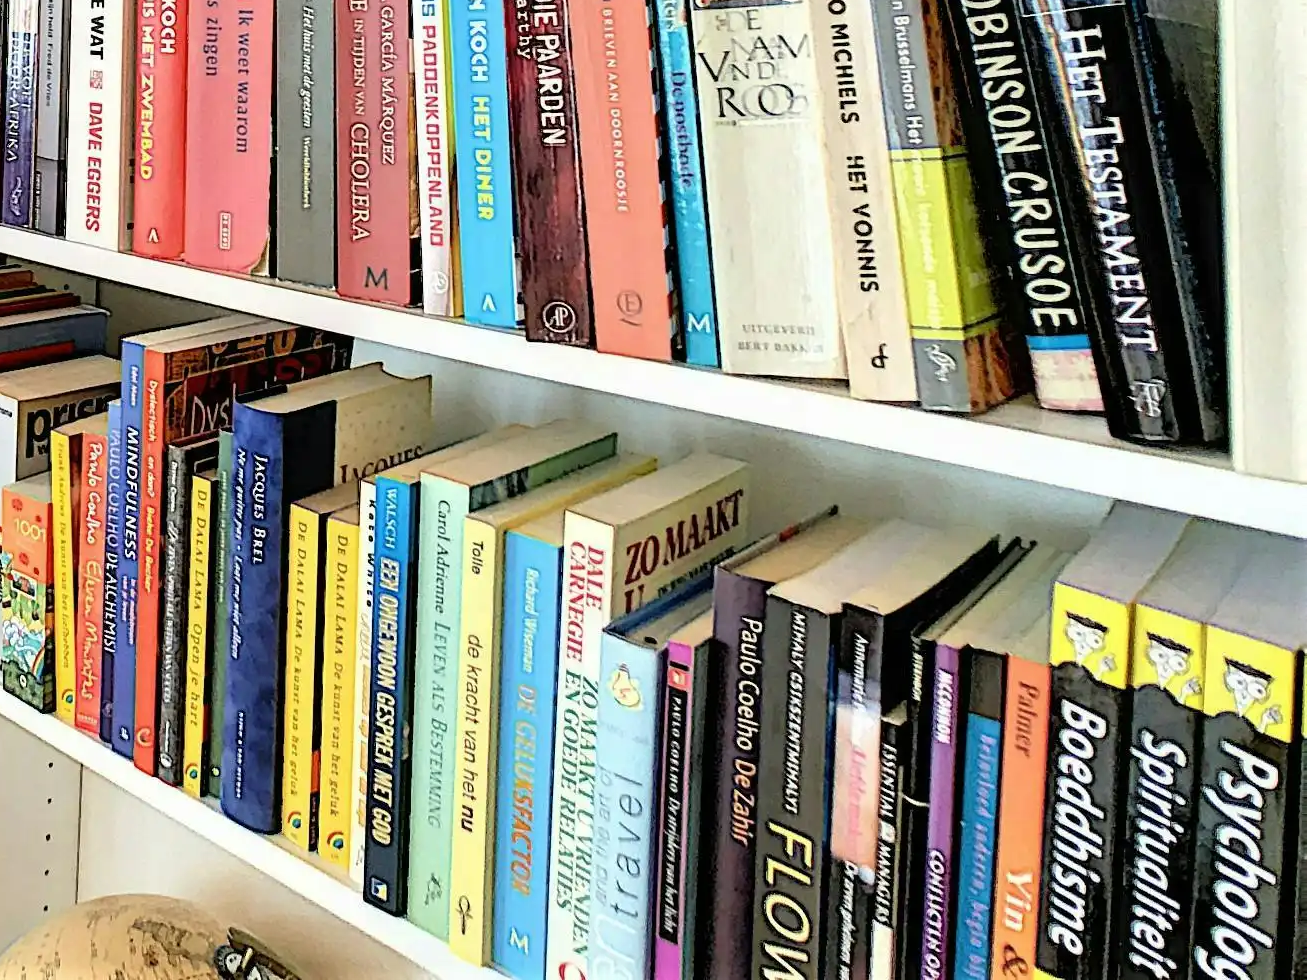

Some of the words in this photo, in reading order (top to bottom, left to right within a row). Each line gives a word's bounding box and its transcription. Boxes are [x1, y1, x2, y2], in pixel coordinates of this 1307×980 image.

[89, 15, 105, 60] WAT
[140, 24, 156, 67] MET
[205, 16, 221, 77] zingen
[237, 9, 253, 27] Ik
[352, 19, 364, 35] IN
[380, 6, 394, 72] GARCÍA
[237, 31, 251, 76] weet
[352, 36, 365, 88] TIJDEN
[468, 20, 489, 82] KOCH
[830, 23, 860, 124] MICHIELS
[891, 15, 917, 111] Brusselmans
[1061, 24, 1106, 104] HET
[235, 82, 250, 154] waarom
[353, 89, 365, 116] VAN
[380, 76, 397, 164] MÁRQUEZ
[472, 96, 492, 141] HET
[534, 33, 565, 146] PAARDEN
[87, 102, 104, 150] DAVE
[139, 73, 155, 180] ZWEMBAD
[421, 26, 444, 247] PADDENKOPPENLAND
[900, 115, 924, 146] Het
[84, 155, 103, 232] EGGERS
[349, 122, 371, 242] CHOLERA
[474, 149, 494, 221] DINER
[845, 155, 868, 194] HET
[851, 202, 880, 293] VONNIS
[1002, 170, 1079, 328] CRUSOE
[1082, 115, 1158, 353] TESTAMENT
[364, 266, 389, 290] M
[686, 311, 712, 335] M
[124, 426, 139, 561] MINDFULNESS
[252, 454, 270, 519] JACQUES
[253, 527, 267, 565] BREL
[380, 556, 401, 593] EEN
[471, 541, 484, 574] Tolle
[567, 541, 587, 663] CARNEGIE
[587, 545, 604, 610] DALE
[376, 595, 400, 691] ONGEWOON
[468, 634, 481, 659] de
[740, 615, 764, 676] Paulo
[465, 662, 482, 724] kracht
[735, 678, 759, 753] Coelho
[1015, 680, 1040, 758] Palmer
[374, 692, 397, 771] GESPREK
[464, 727, 478, 763] van
[372, 772, 392, 802] MET
[463, 767, 477, 802] het
[734, 756, 759, 779] De
[370, 806, 392, 846] GOD
[460, 806, 475, 833] nu
[610, 771, 643, 919] travel
[731, 783, 757, 846] Zahir
[1047, 698, 1107, 956] Boeddhisme
[1128, 729, 1191, 980] Spiritualiteit
[1005, 870, 1034, 933] Yin
[1002, 944, 1029, 977] &
